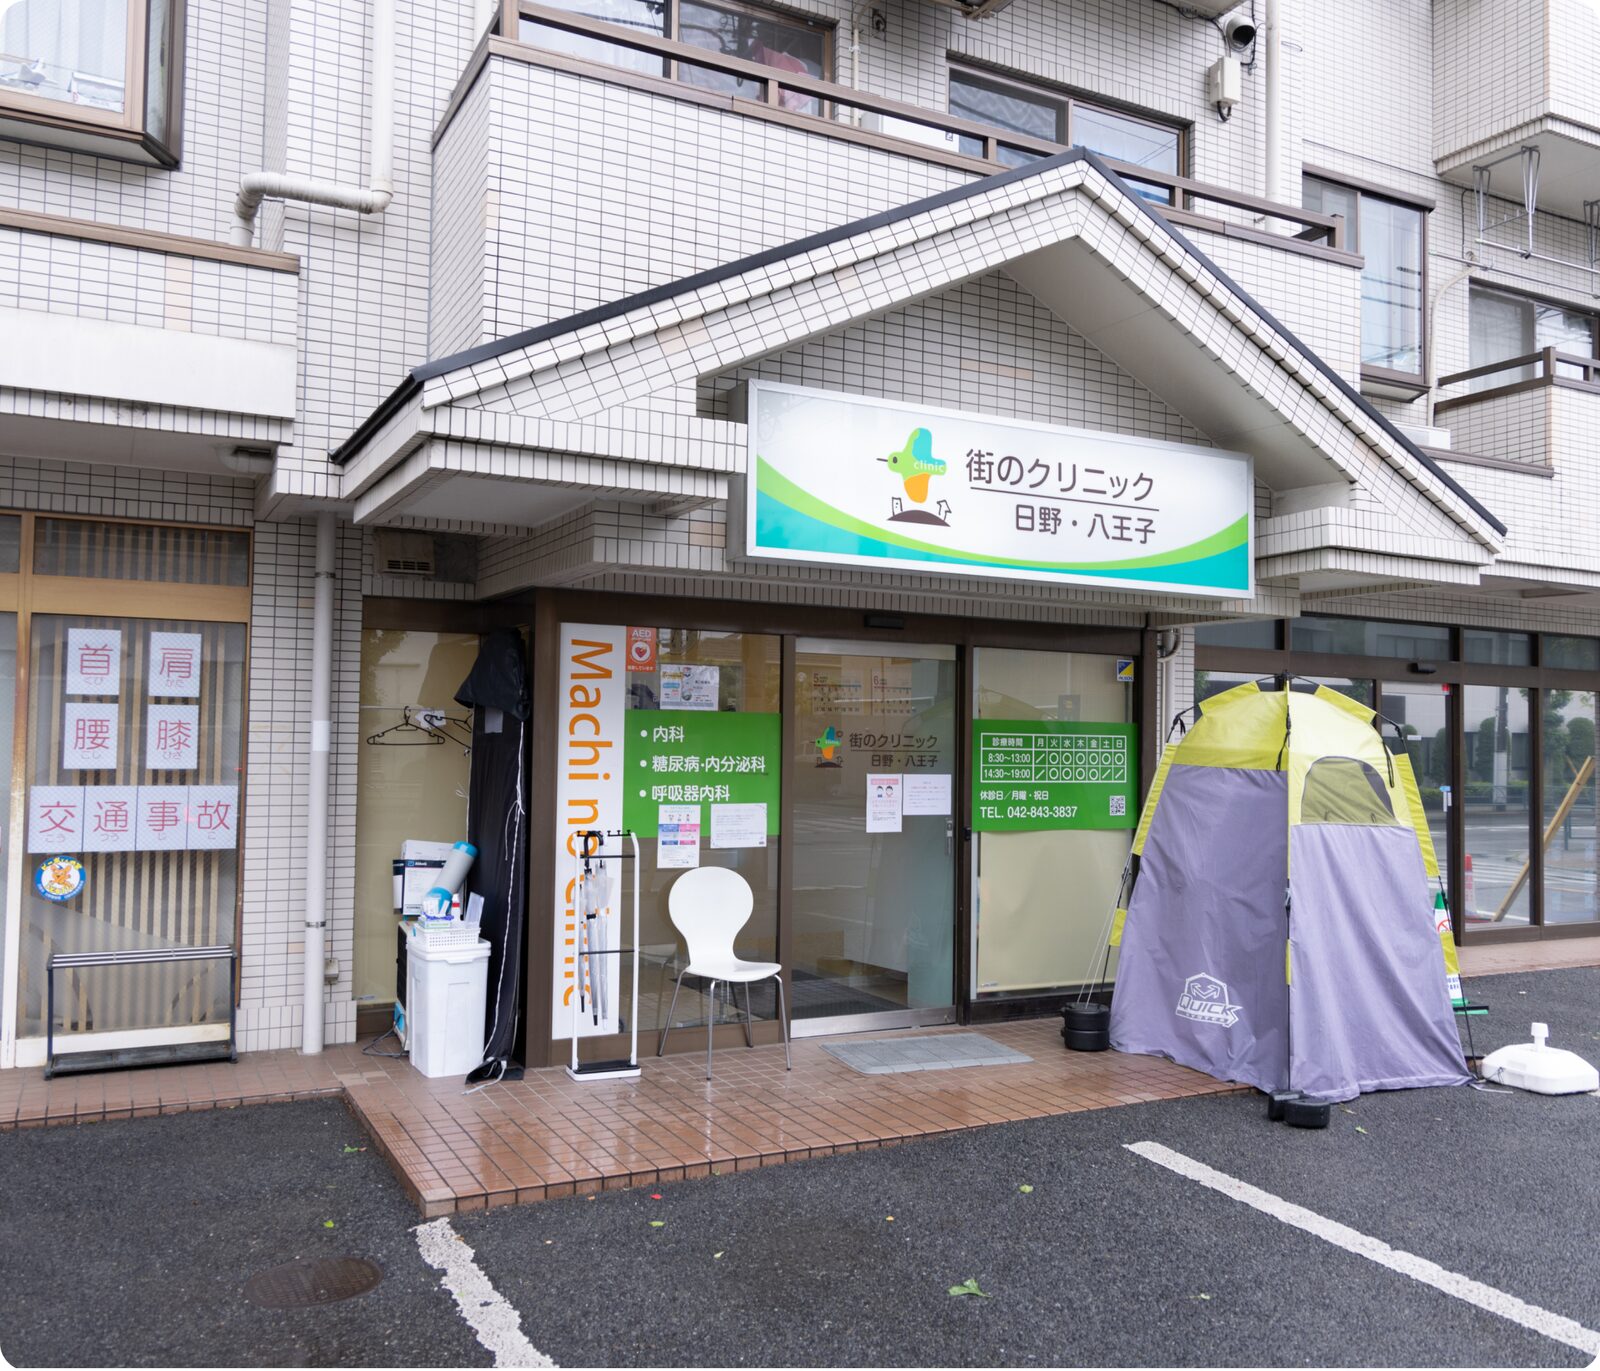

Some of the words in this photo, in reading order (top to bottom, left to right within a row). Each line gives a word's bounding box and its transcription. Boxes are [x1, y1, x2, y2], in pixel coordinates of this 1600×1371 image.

[914, 460, 945, 473] clinic
[965, 449, 1154, 501] 街のクリニック
[1015, 504, 1156, 544] 日野・八王子
[632, 629, 652, 638] AED
[79, 643, 113, 676] 首
[159, 647, 194, 679] 肩
[569, 638, 613, 780] Machi
[74, 718, 110, 750] 腰
[156, 719, 191, 750] 膝
[652, 726, 685, 743] 内科
[849, 733, 938, 749] 街のクリニック
[991, 737, 1023, 747] 診療時間
[1037, 738, 1044, 747] 月
[1050, 738, 1058, 747] 火
[1063, 738, 1071, 748] 水
[1077, 738, 1085, 748] 木
[1090, 739, 1097, 748] 金
[1103, 739, 1110, 748] 土
[1116, 739, 1123, 748] 日
[652, 755, 766, 773] 糖尿病・内分泌科
[871, 754, 938, 768] 日野・八王子
[652, 785, 730, 802] 呼吸器内科
[39, 800, 231, 833] 交通事故
[980, 807, 1004, 818] TEL.
[1007, 806, 1078, 818] 042-843-3837
[1180, 994, 1237, 1016] QUICK
